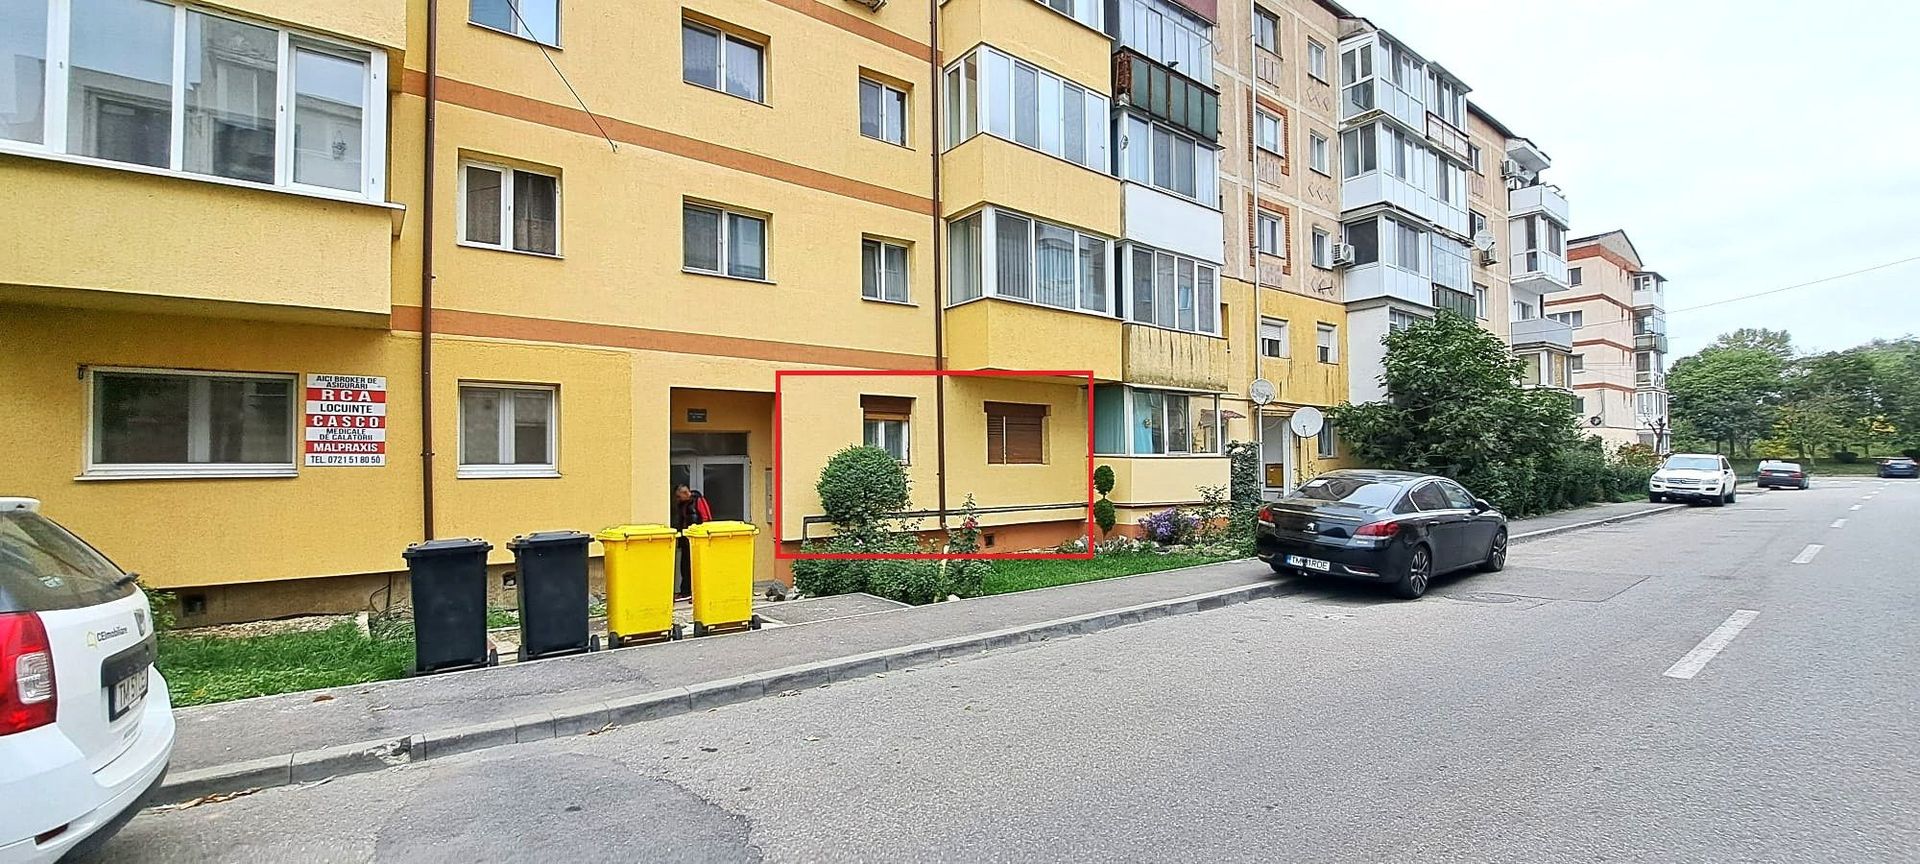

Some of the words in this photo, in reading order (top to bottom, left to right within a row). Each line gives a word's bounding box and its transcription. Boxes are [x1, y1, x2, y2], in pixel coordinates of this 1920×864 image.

[334, 376, 366, 384] BROKER
[321, 389, 372, 402] RCA
[312, 415, 379, 428] CASCO
[313, 443, 378, 452] MALPRAXIS
[327, 455, 347, 464] 0721
[348, 455, 358, 464] 51
[360, 455, 370, 464] 80
[371, 455, 381, 464] 50
